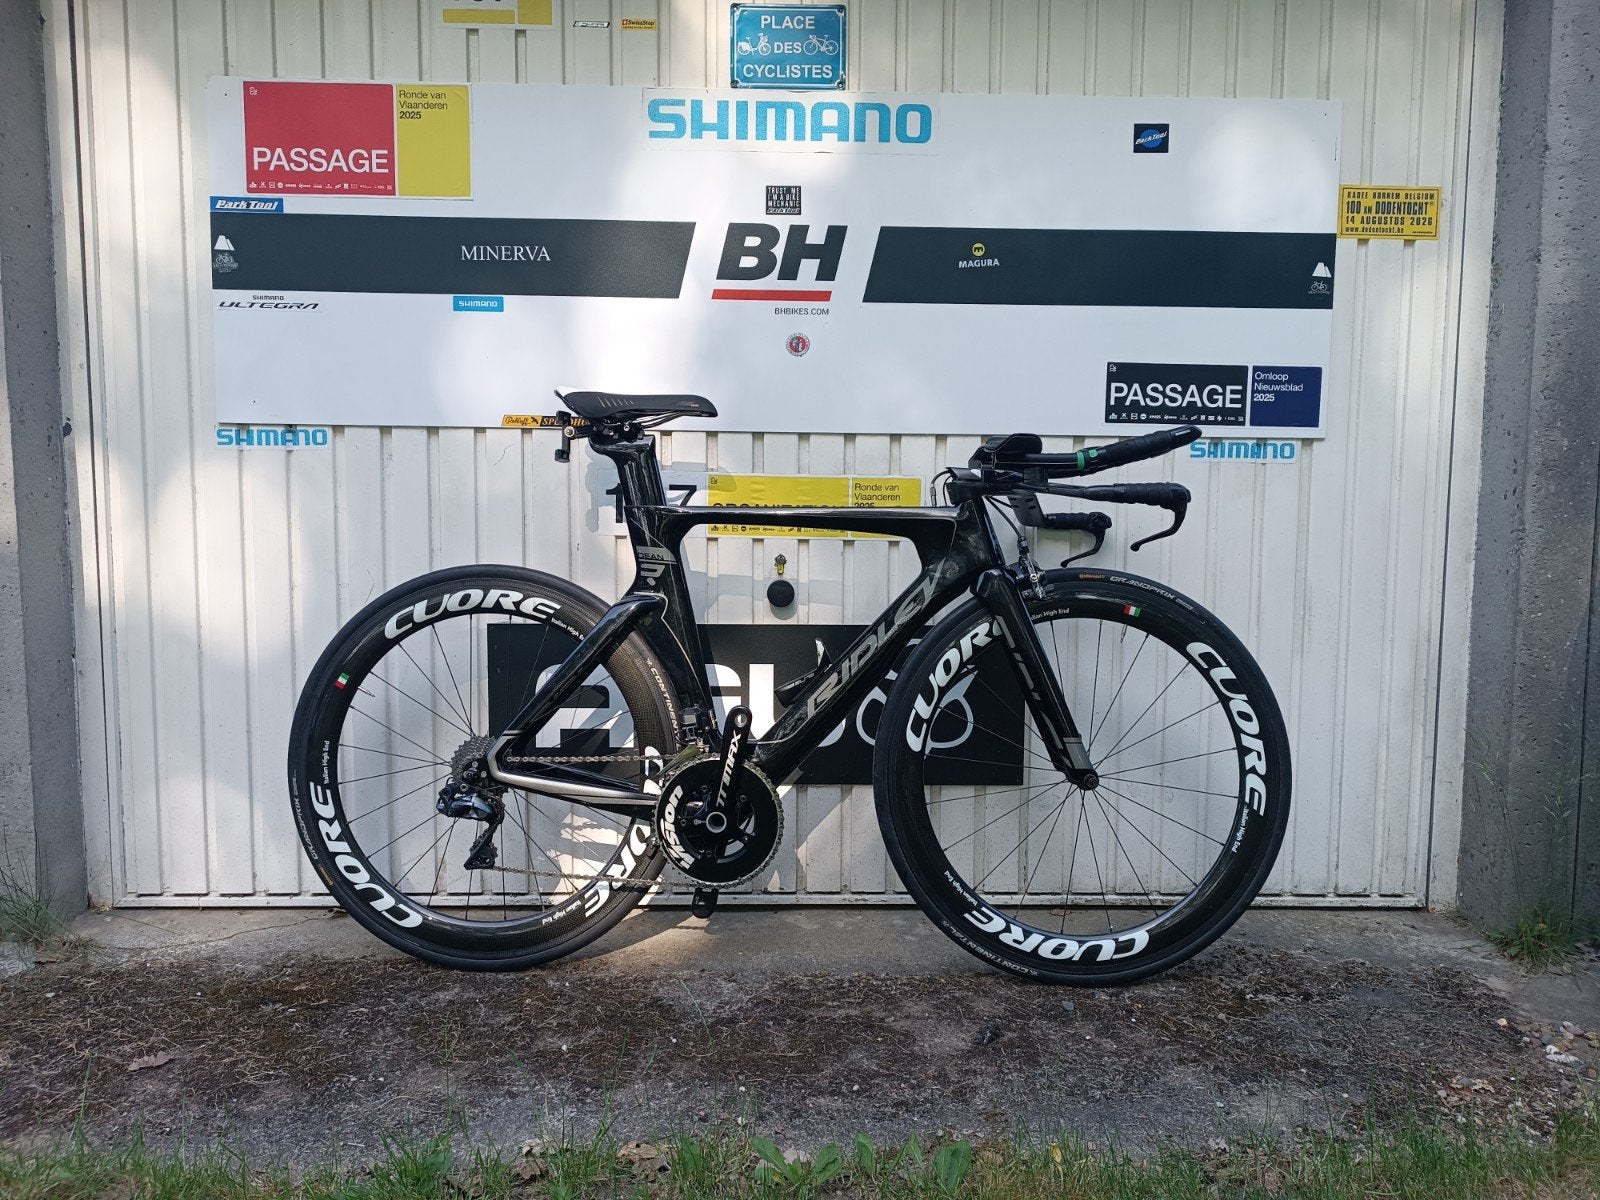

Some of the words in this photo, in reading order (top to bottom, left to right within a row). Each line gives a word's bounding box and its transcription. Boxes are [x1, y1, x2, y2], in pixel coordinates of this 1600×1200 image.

[760, 15, 815, 29] PLACE
[774, 42, 802, 54] DES
[743, 64, 833, 79] CYCLISTES
[399, 90, 428, 99] Ronde
[399, 100, 448, 110] Vlaanderen
[399, 111, 422, 119] 2025
[647, 98, 932, 144] SHIMANO
[252, 147, 389, 173] PASSAGE
[1405, 192, 1435, 200] BELGIUM
[1346, 201, 1361, 215] 100
[1345, 216, 1355, 225] 14
[1360, 216, 1405, 226] AUGUSTUS
[461, 245, 551, 261] MINERVA
[716, 223, 848, 281] BH
[958, 258, 1000, 269] MAGURA
[218, 301, 319, 310] ULTEGRA
[774, 308, 830, 316] BHBIKES.COM
[1254, 372, 1289, 381] Omloop
[1254, 383, 1304, 392] Nieuwsblad
[1110, 382, 1243, 408] PASSAGE
[1253, 393, 1275, 402] 2025
[216, 428, 328, 446] SHIMANO
[1190, 441, 1296, 460] SHIMANO
[854, 483, 883, 491] Ronde
[854, 493, 901, 501] Vlaanderen
[384, 588, 561, 640] CUORE
[1186, 641, 1267, 816] CUORE
[310, 781, 423, 928] CUORE
[963, 906, 1149, 961] CUORE
